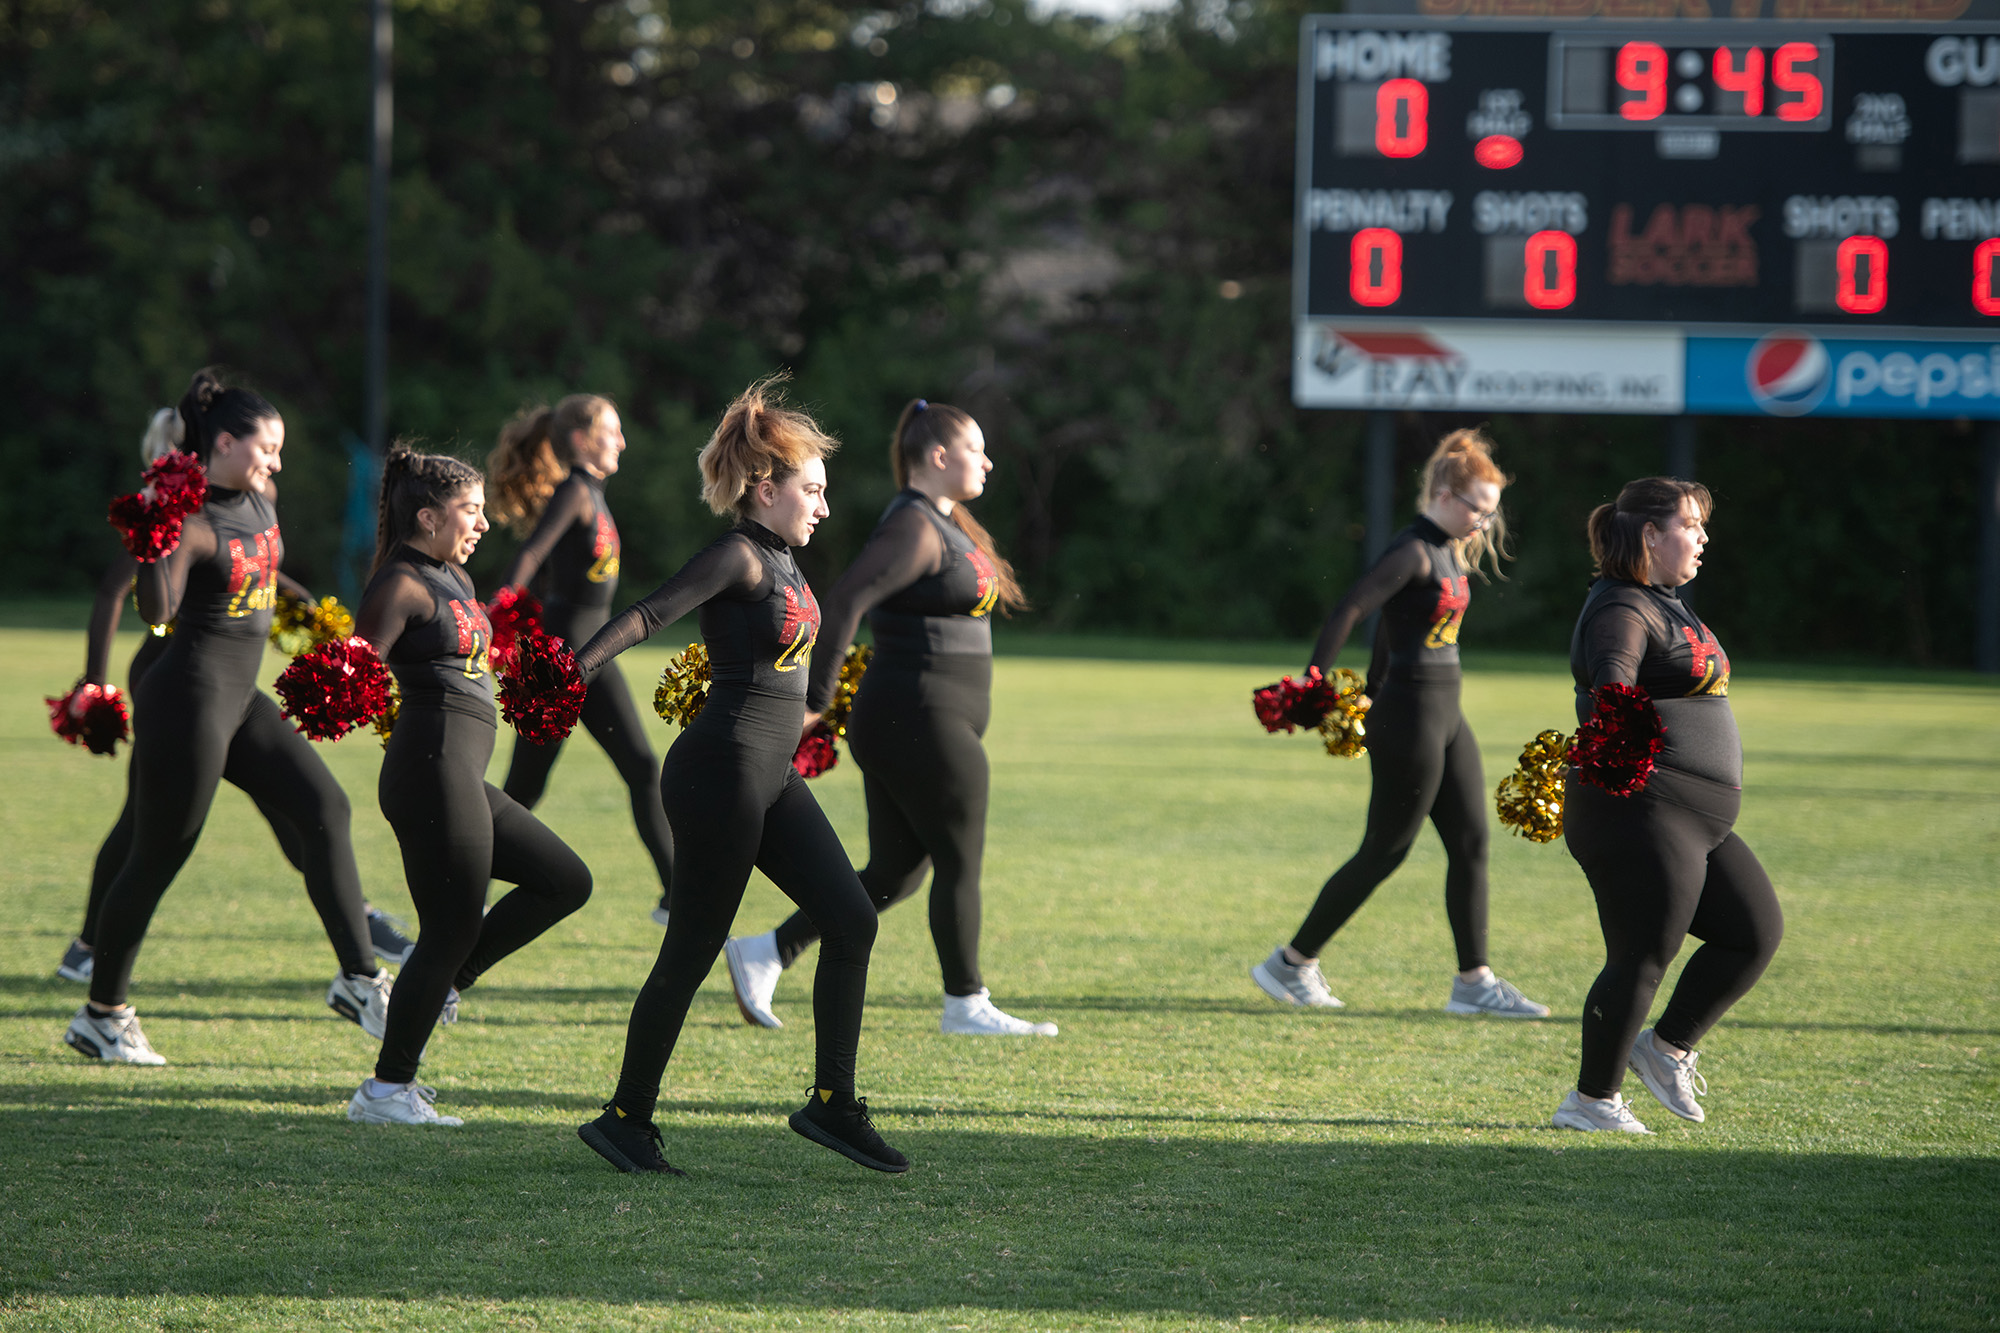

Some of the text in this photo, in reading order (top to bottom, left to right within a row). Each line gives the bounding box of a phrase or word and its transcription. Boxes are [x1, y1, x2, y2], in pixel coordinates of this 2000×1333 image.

[1315, 32, 1452, 82] HOME
[1615, 41, 1824, 121] 9:45
[1376, 78, 1429, 158] 0
[1308, 188, 1453, 234] PENALTY
[1472, 190, 1588, 235] SHOTS
[1607, 203, 1761, 256] LARK
[1783, 194, 1899, 239] SHOTS
[1350, 228, 1403, 307] 0
[1523, 230, 1577, 310] 0
[1835, 235, 1889, 314] 0
